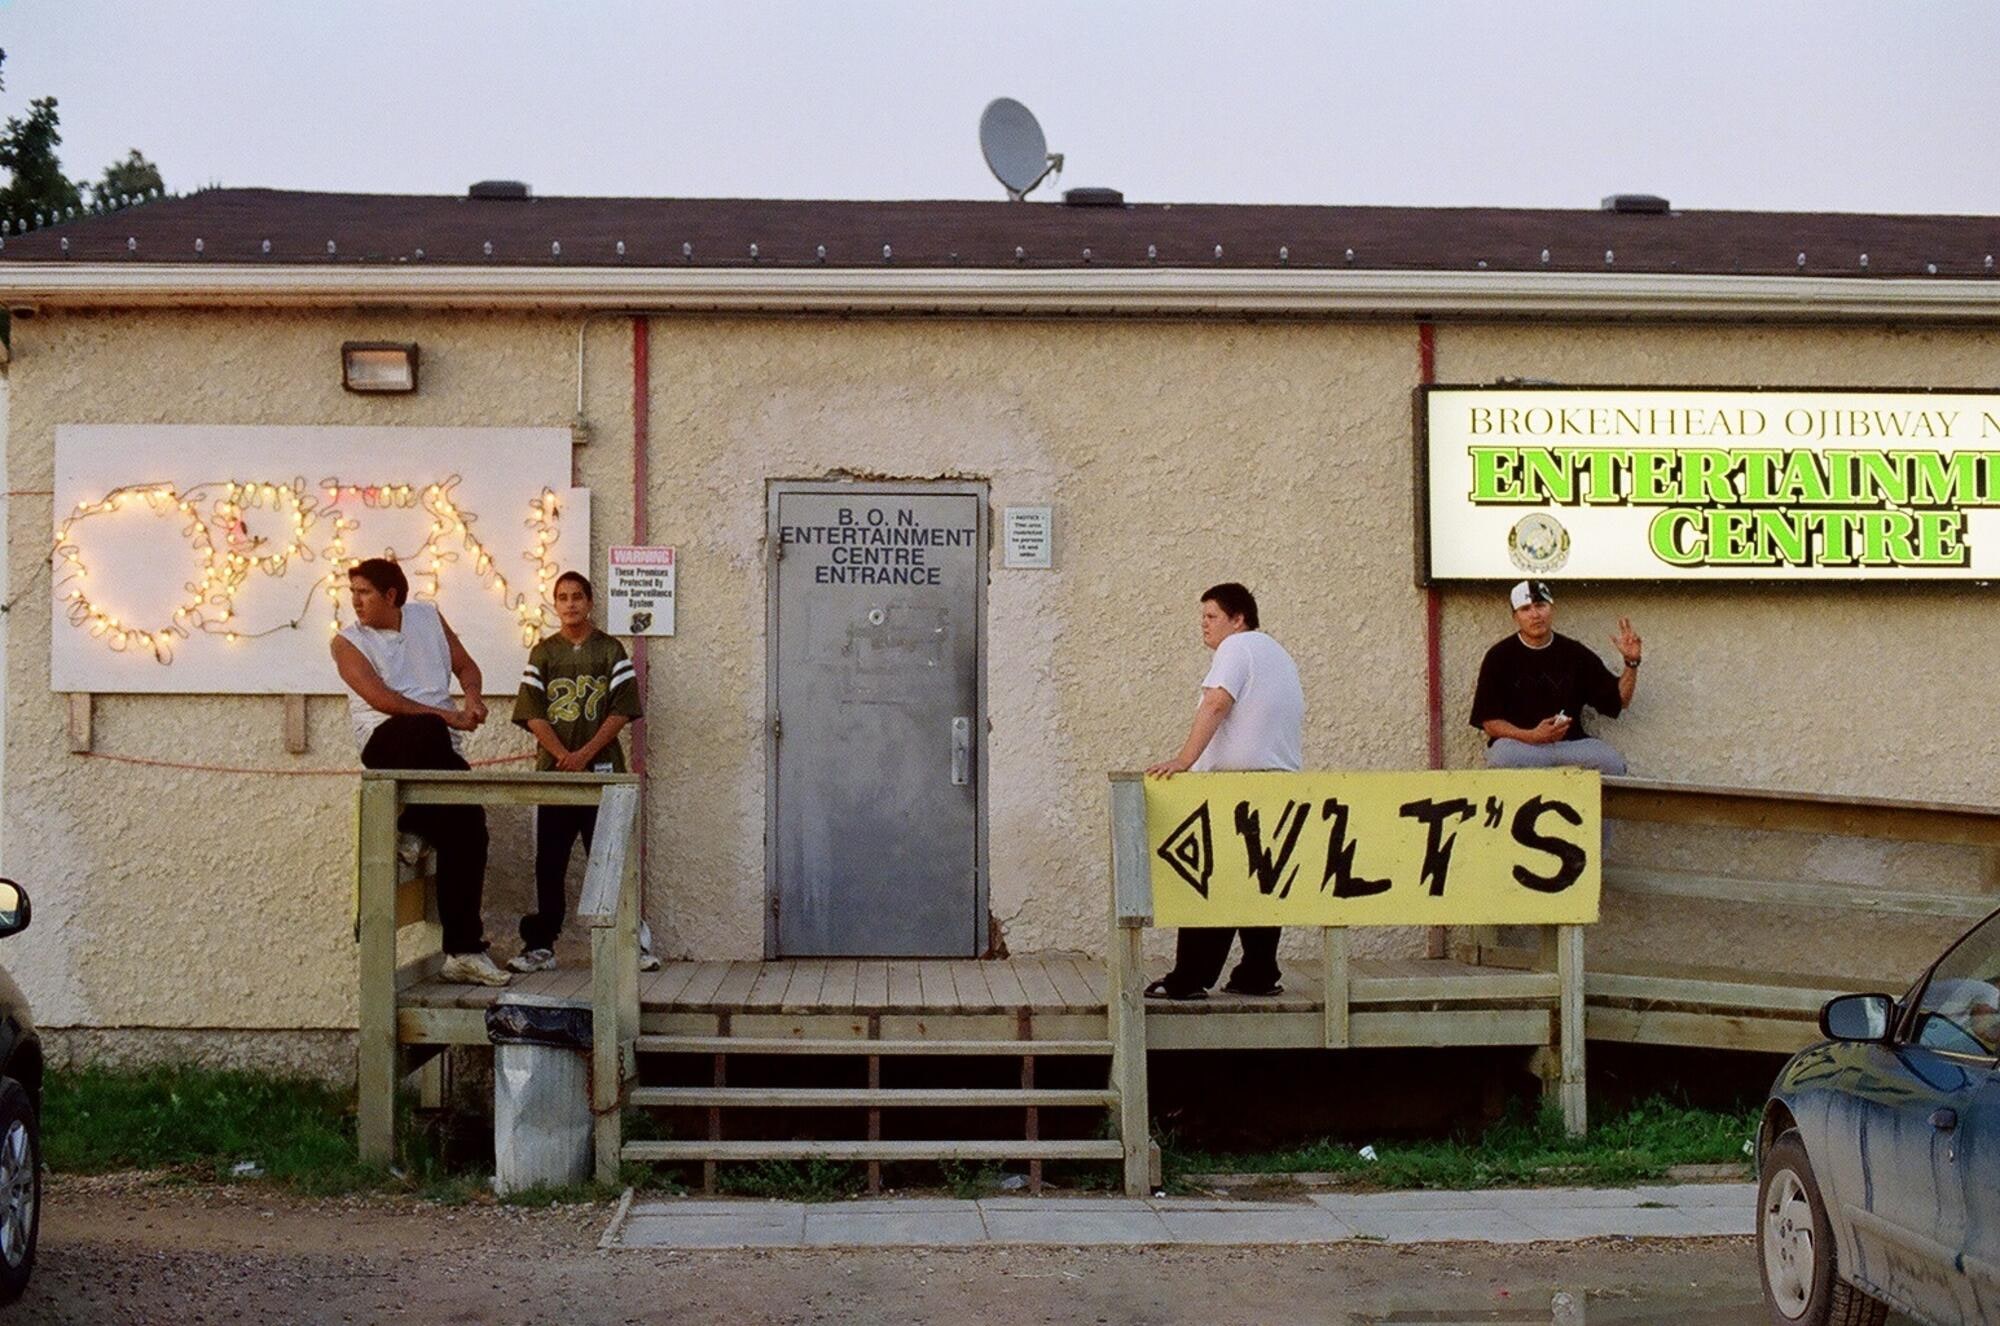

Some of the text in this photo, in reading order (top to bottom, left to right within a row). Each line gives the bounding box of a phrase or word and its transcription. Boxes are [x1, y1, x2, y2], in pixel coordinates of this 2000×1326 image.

[1469, 407, 1766, 436] BROKENHEAD
[1784, 409, 1960, 438] OJIBWAY
[838, 508, 920, 527] B. O. N.
[781, 526, 976, 547] ENTERTAINMENT
[1649, 507, 1971, 568] CENTRE
[614, 550, 670, 564] WARNING
[832, 547, 925, 565] CENTRE
[48, 474, 562, 666] OPEN
[615, 568, 668, 577] These Premises
[815, 566, 941, 585] ENTRANCE
[610, 588, 672, 597] Video Surveillance
[620, 578, 663, 588] Protected By
[629, 599, 654, 608] System
[547, 674, 607, 724] 27
